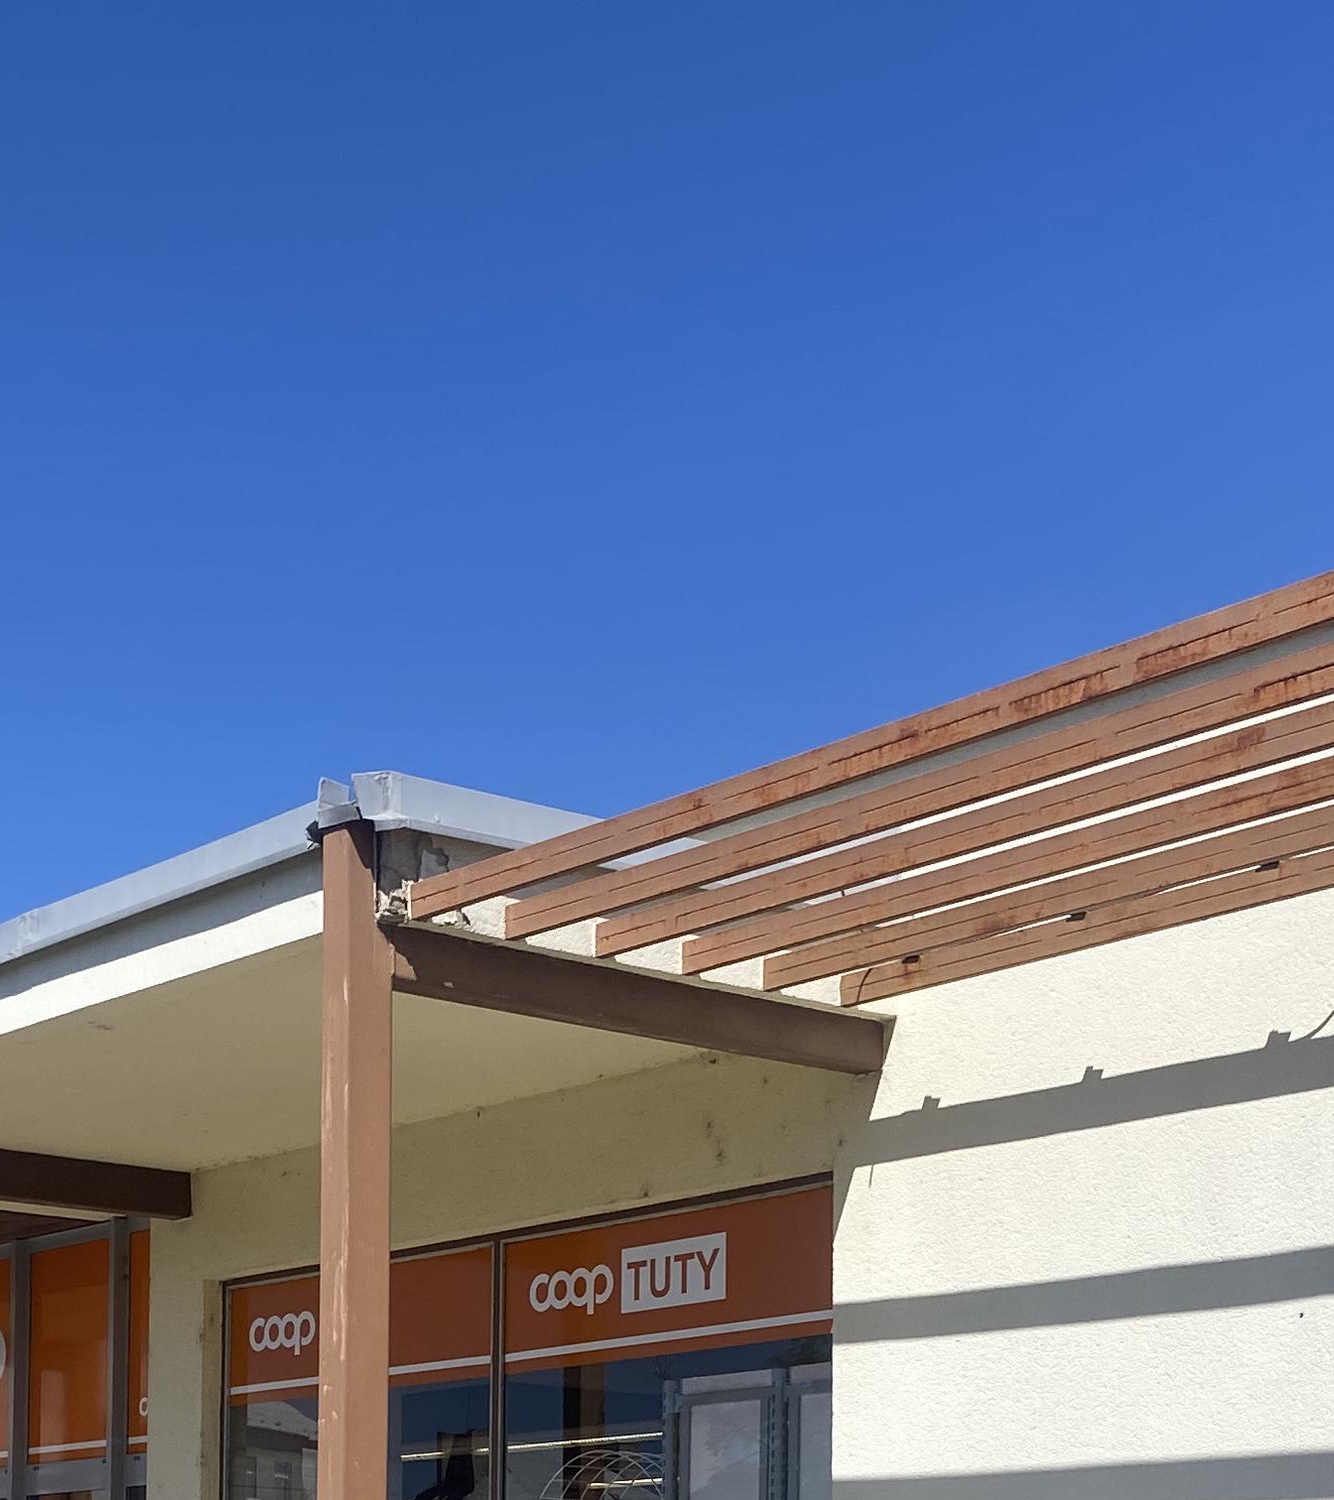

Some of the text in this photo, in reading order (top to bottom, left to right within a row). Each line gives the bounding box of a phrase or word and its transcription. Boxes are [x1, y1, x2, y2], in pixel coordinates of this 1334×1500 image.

[529, 1248, 720, 1315] coop TUTY
[249, 1310, 316, 1355] coop
